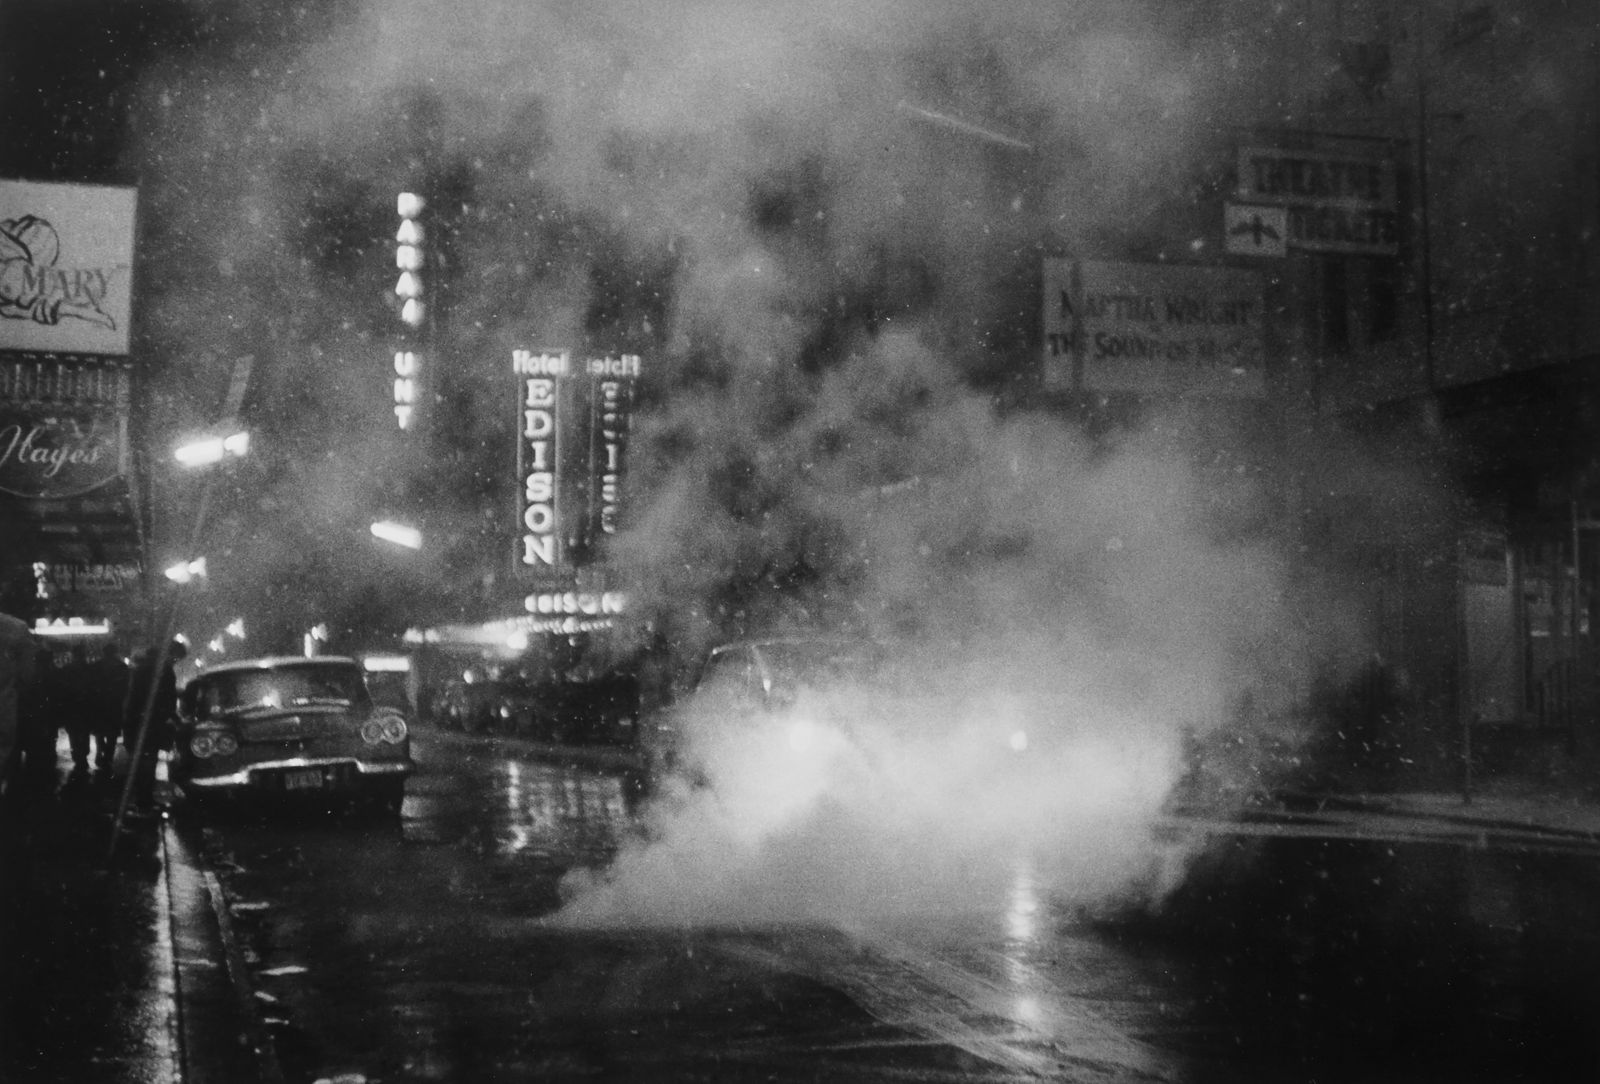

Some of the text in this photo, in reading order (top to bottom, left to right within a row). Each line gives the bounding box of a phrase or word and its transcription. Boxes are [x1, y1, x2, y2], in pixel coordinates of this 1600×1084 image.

[512, 350, 568, 375] Hotel
[0, 423, 104, 478] Hayes
[523, 379, 553, 565] EDISON
